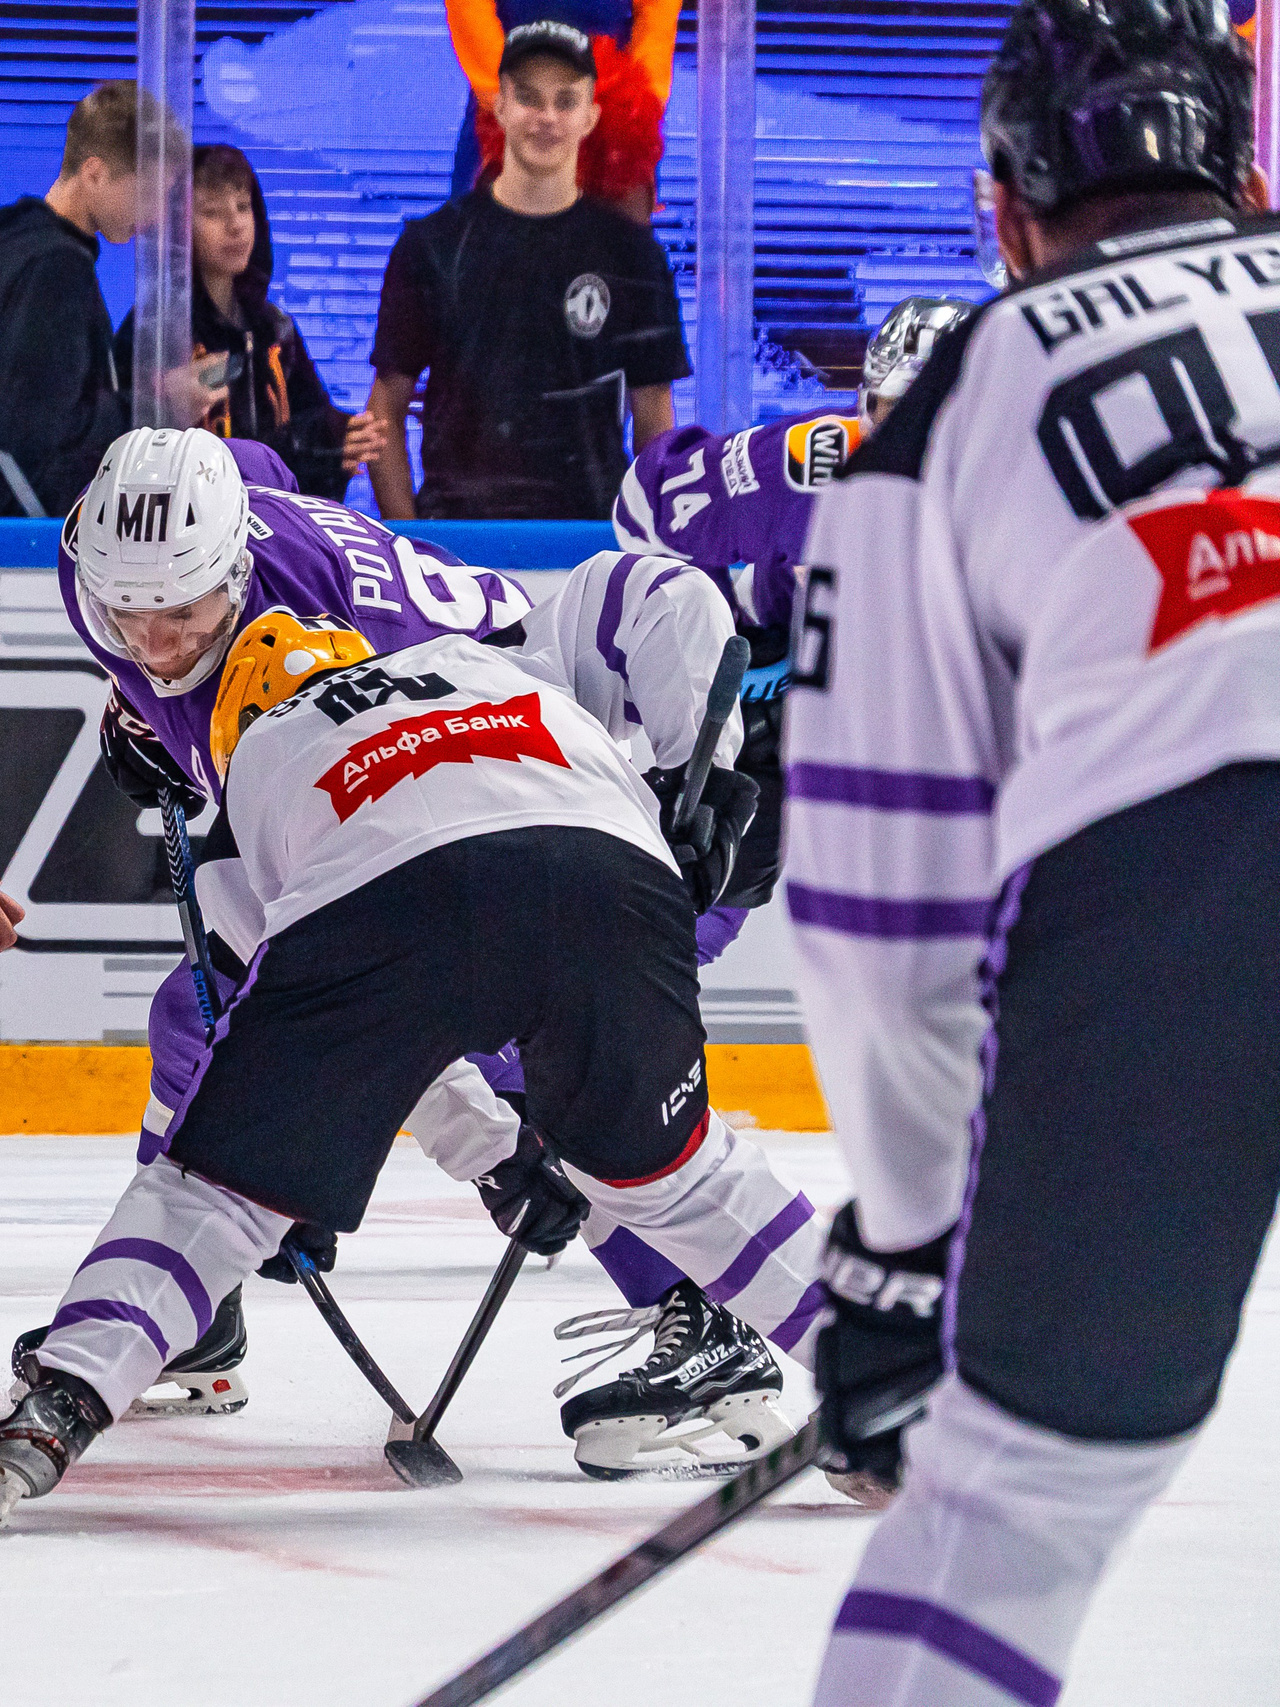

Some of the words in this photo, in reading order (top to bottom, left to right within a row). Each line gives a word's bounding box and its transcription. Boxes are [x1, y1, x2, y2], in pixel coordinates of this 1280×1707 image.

[661, 447, 712, 533] 74
[344, 729, 443, 794] Альфа
[444, 714, 531, 736] Банк
[677, 1343, 730, 1384] SOYUZ
